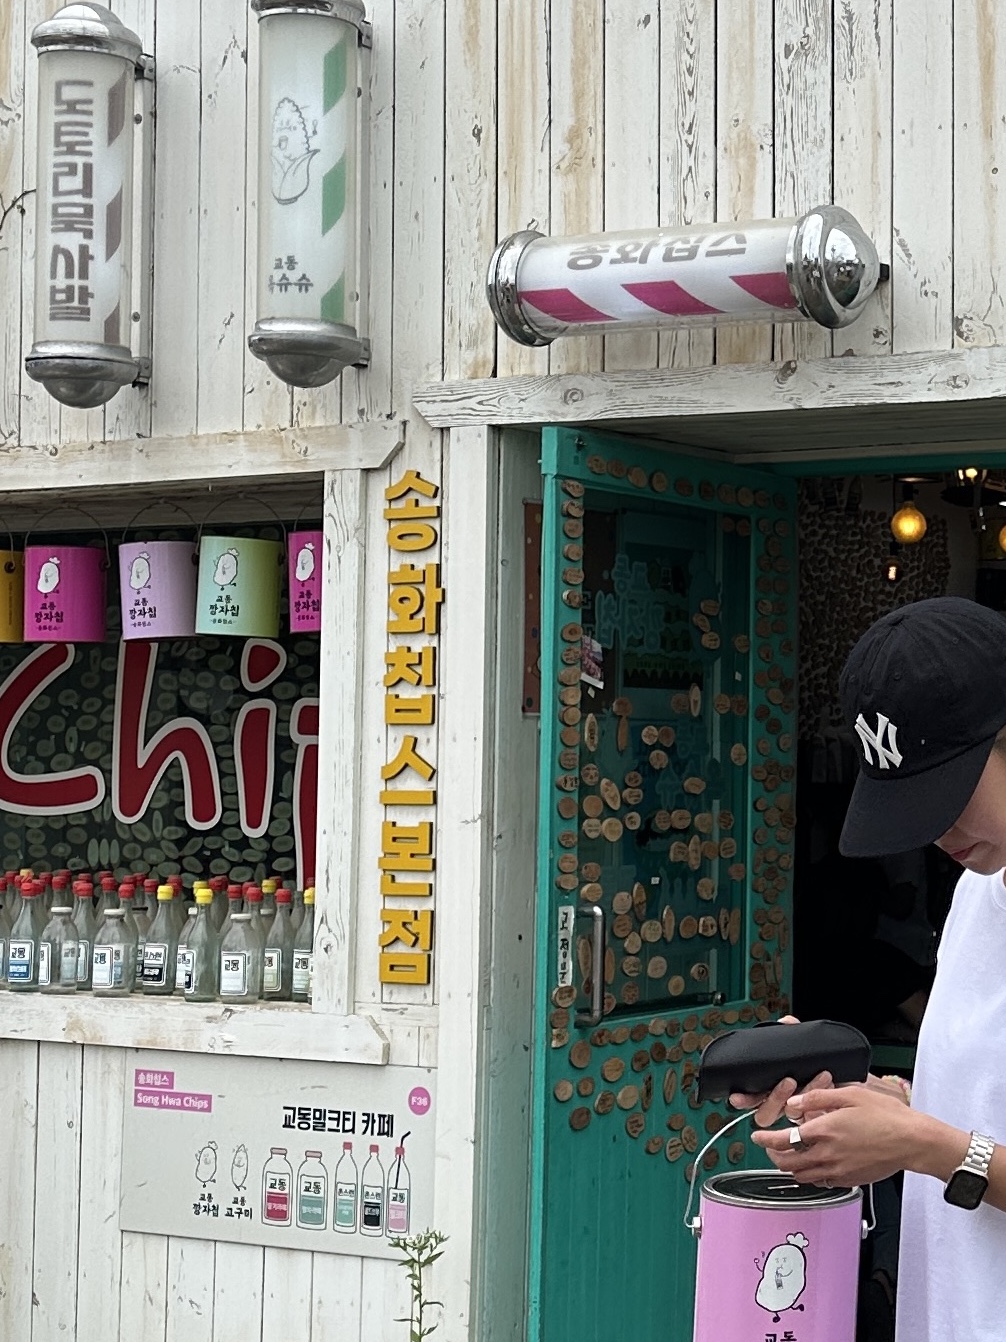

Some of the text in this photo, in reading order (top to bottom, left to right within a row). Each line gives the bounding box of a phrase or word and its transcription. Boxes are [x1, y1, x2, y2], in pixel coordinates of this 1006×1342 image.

[49, 80, 94, 321] 도토리묵사발
[273, 255, 299, 270] 교동
[854, 711, 903, 770] NY
[138, 1072, 170, 1086] 송화칩스
[137, 1093, 209, 1110] Song Hwa Chips
[282, 1106, 394, 1138] 교동밀크티 카페
[269, 1178, 287, 1191] 교동
[303, 1181, 321, 1194] 교동
[225, 1207, 252, 1219] 고구미
